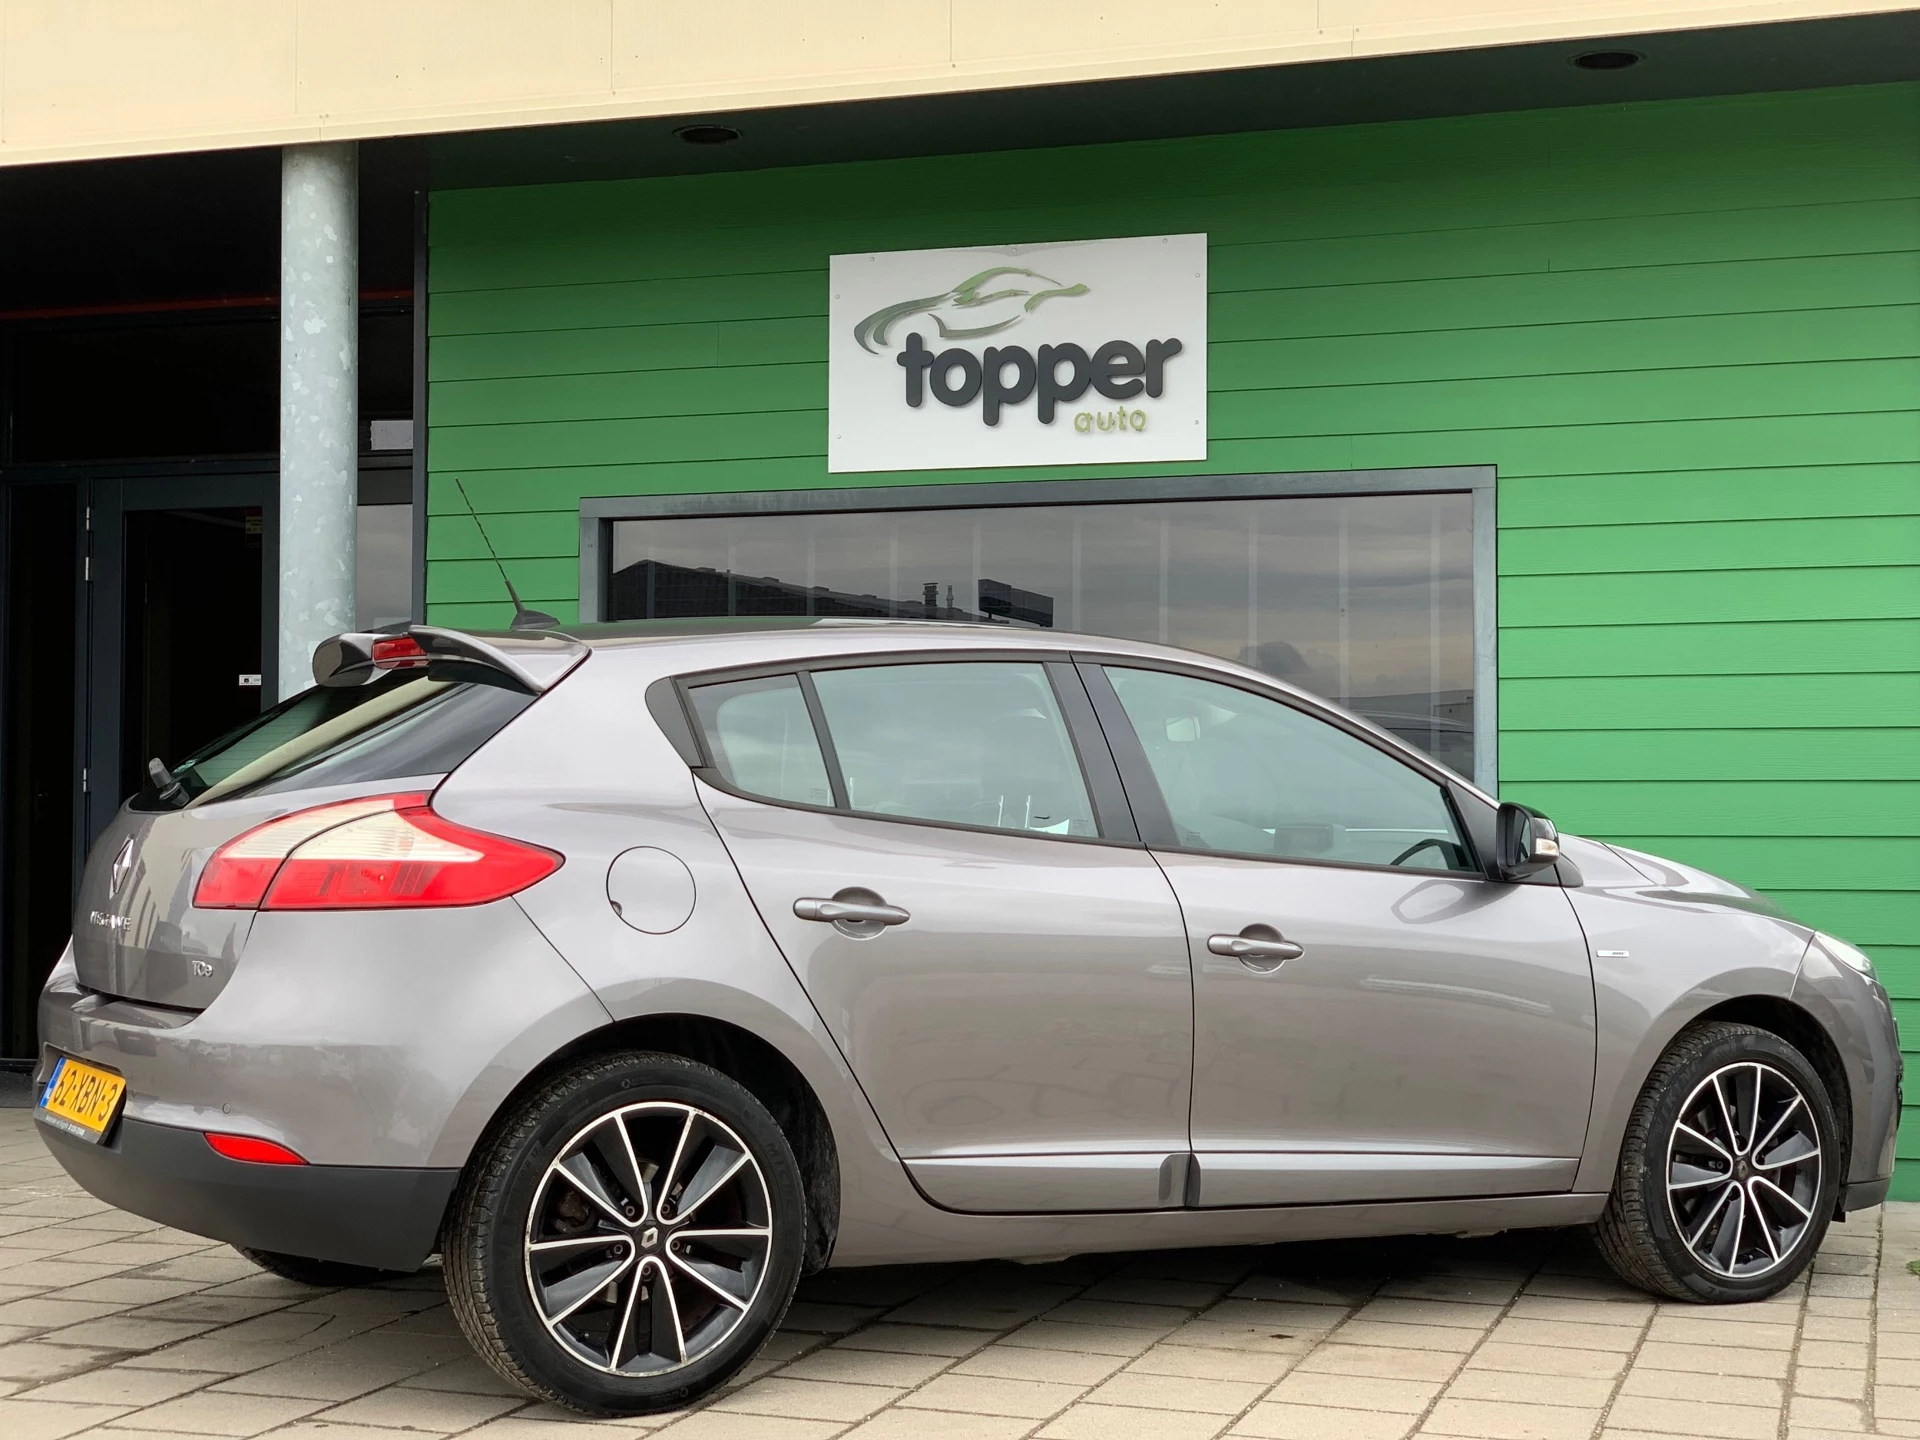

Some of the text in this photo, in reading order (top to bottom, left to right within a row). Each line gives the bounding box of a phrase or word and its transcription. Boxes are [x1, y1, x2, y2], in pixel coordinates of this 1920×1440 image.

[896, 332, 1183, 427] topper
[1073, 406, 1147, 433] auto
[192, 961, 213, 977] TCe
[53, 1067, 119, 1122] 62-XBN-3
